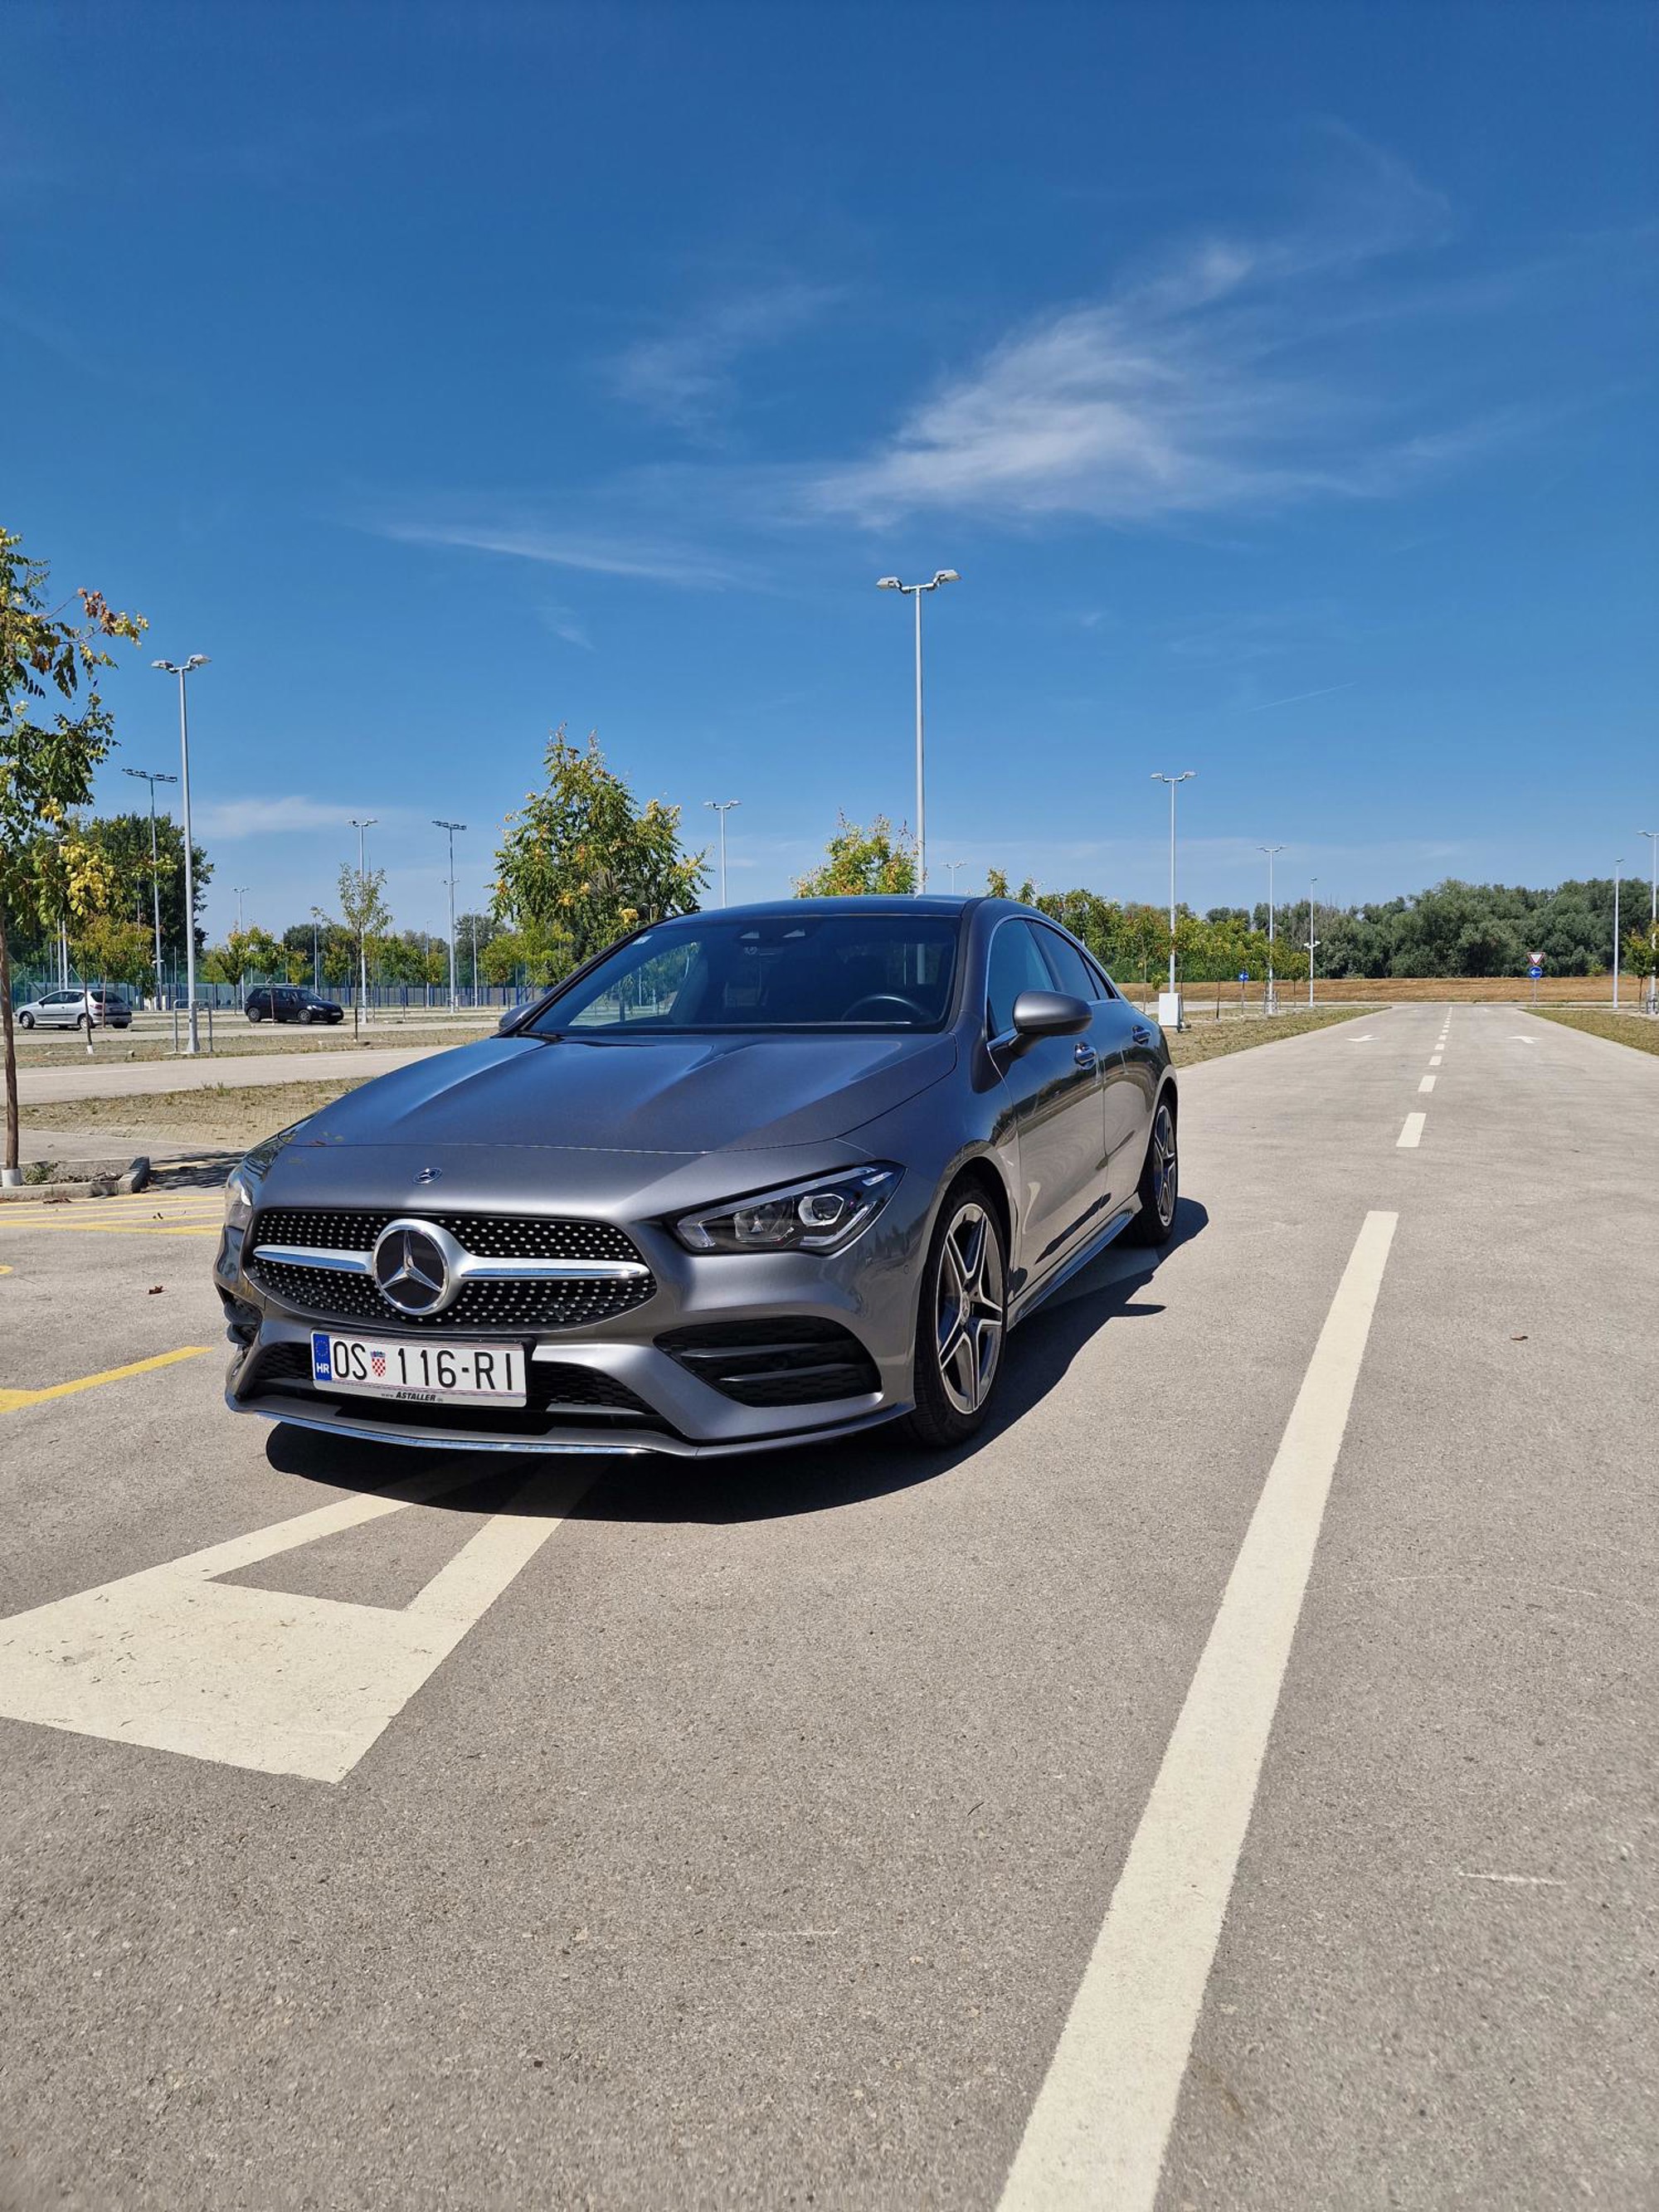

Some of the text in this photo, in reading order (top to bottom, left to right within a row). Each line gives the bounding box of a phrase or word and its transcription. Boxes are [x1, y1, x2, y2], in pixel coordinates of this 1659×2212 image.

[316, 1362, 330, 1374] HR
[333, 1340, 513, 1391] OS 116-RI
